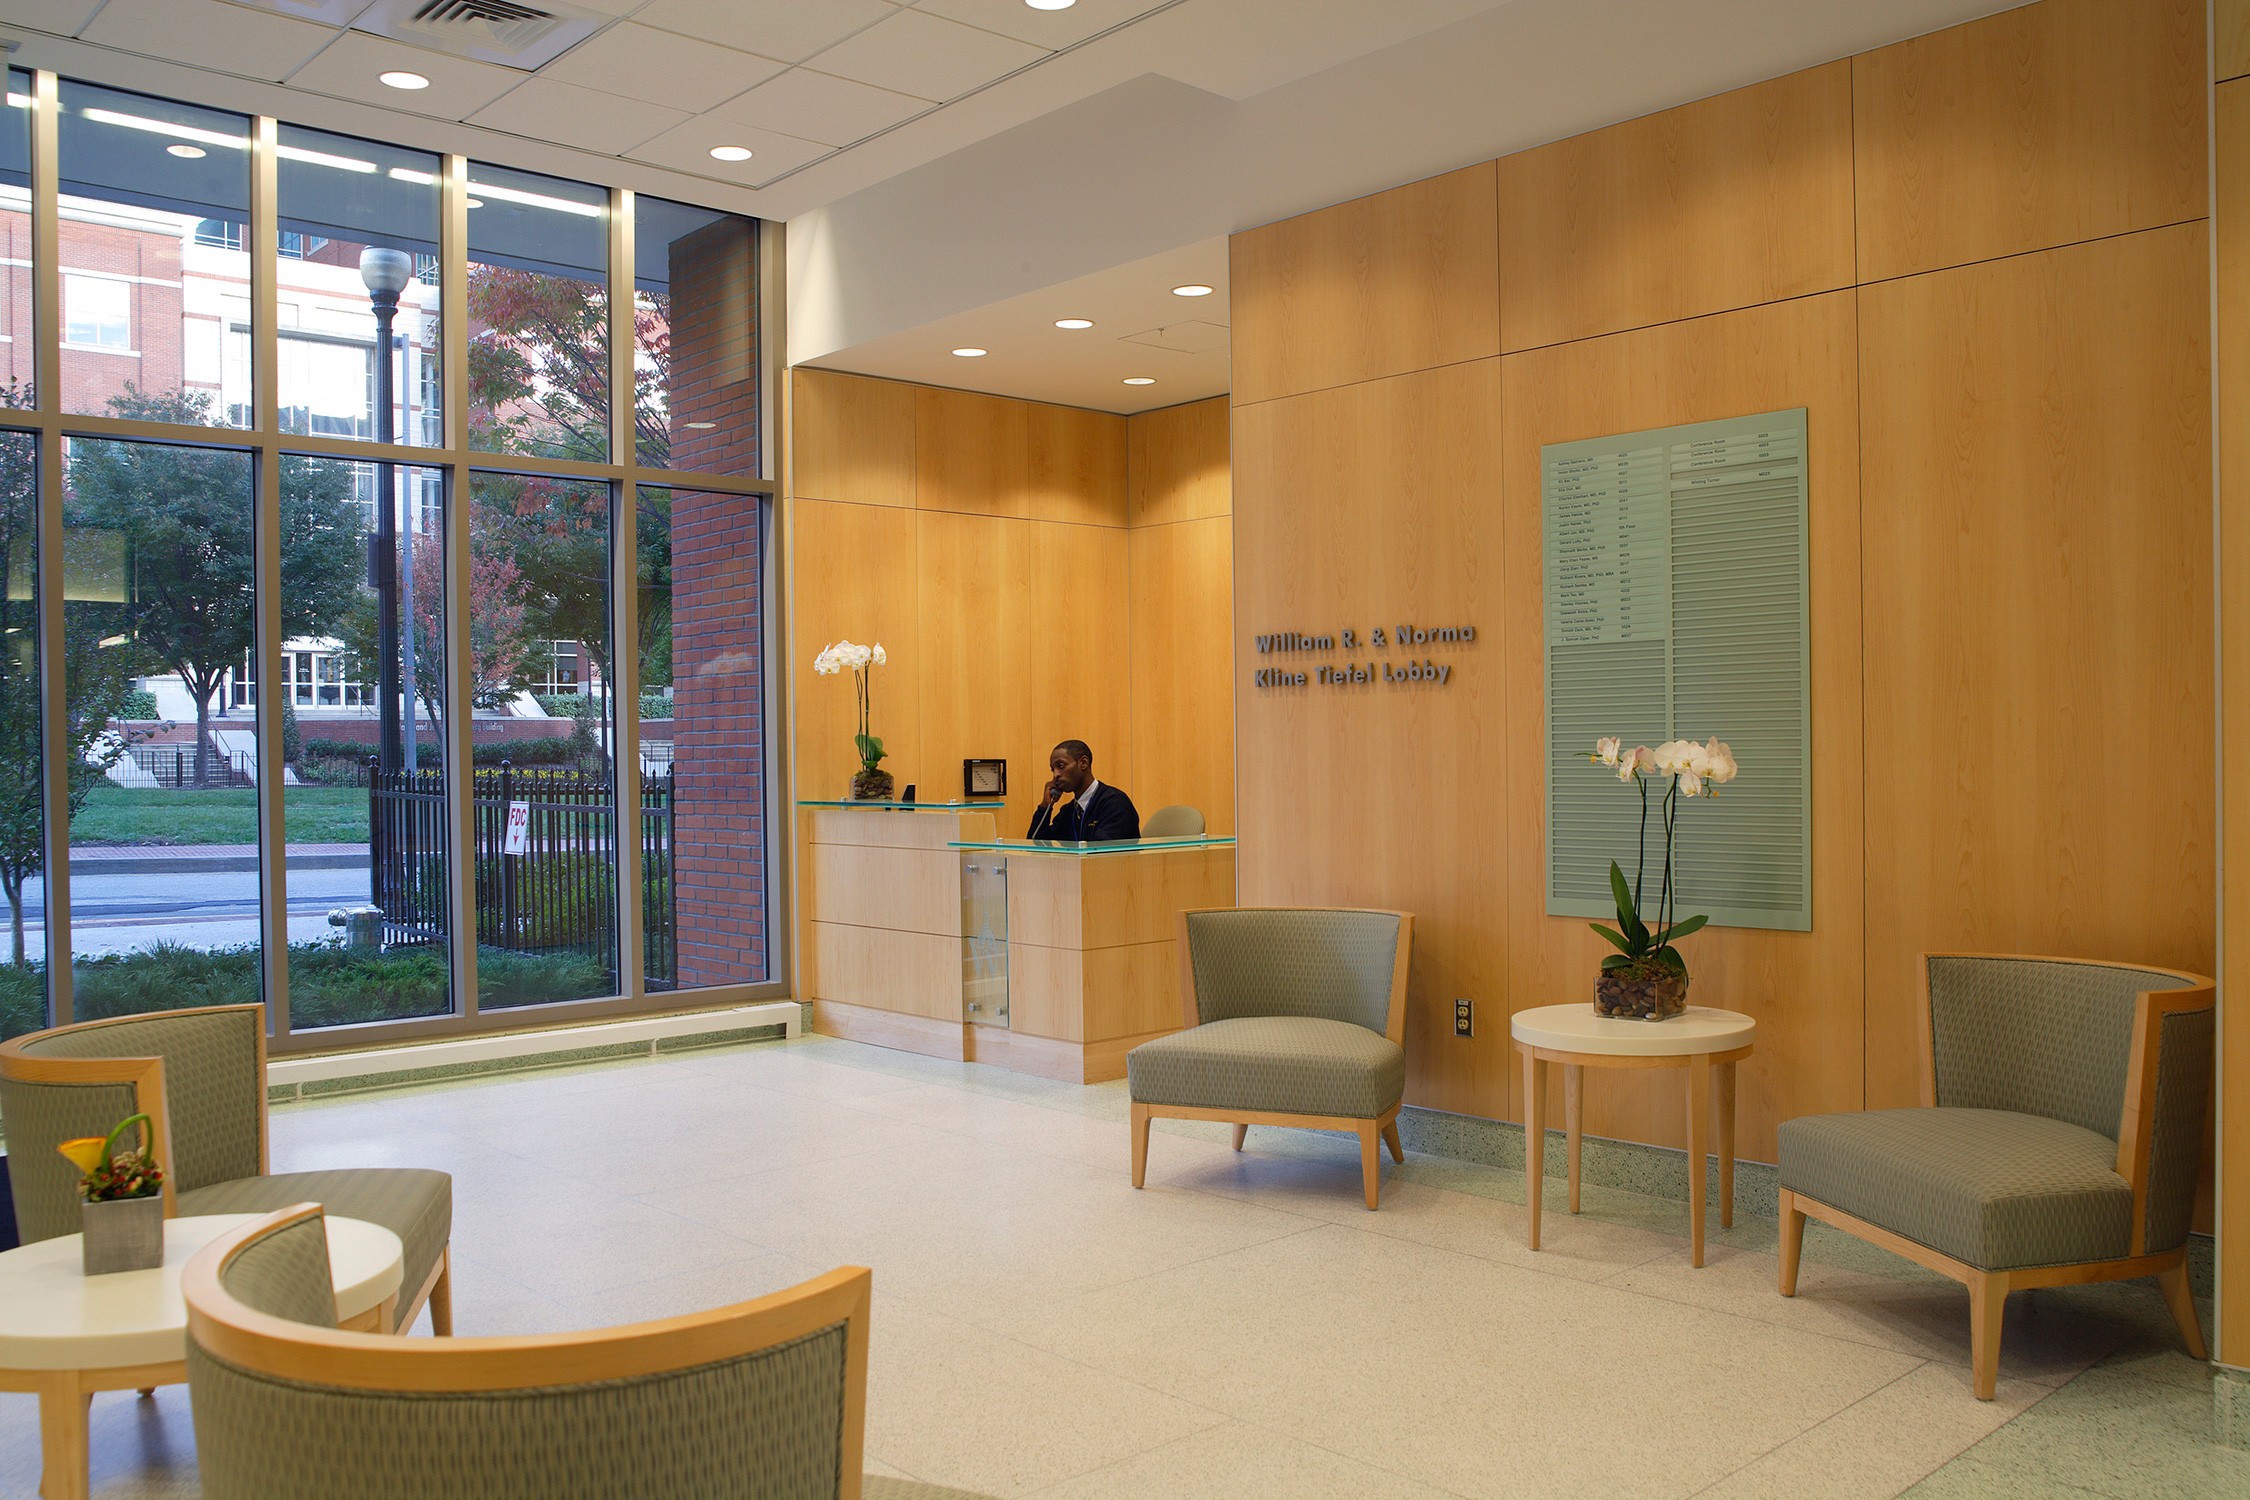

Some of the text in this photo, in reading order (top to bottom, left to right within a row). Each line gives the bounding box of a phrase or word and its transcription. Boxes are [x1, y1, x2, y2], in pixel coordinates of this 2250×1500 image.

[1254, 624, 1475, 653] William R. & Norma
[1254, 659, 1452, 688] Kline Tiefel Lobby
[509, 807, 527, 827] FDC
